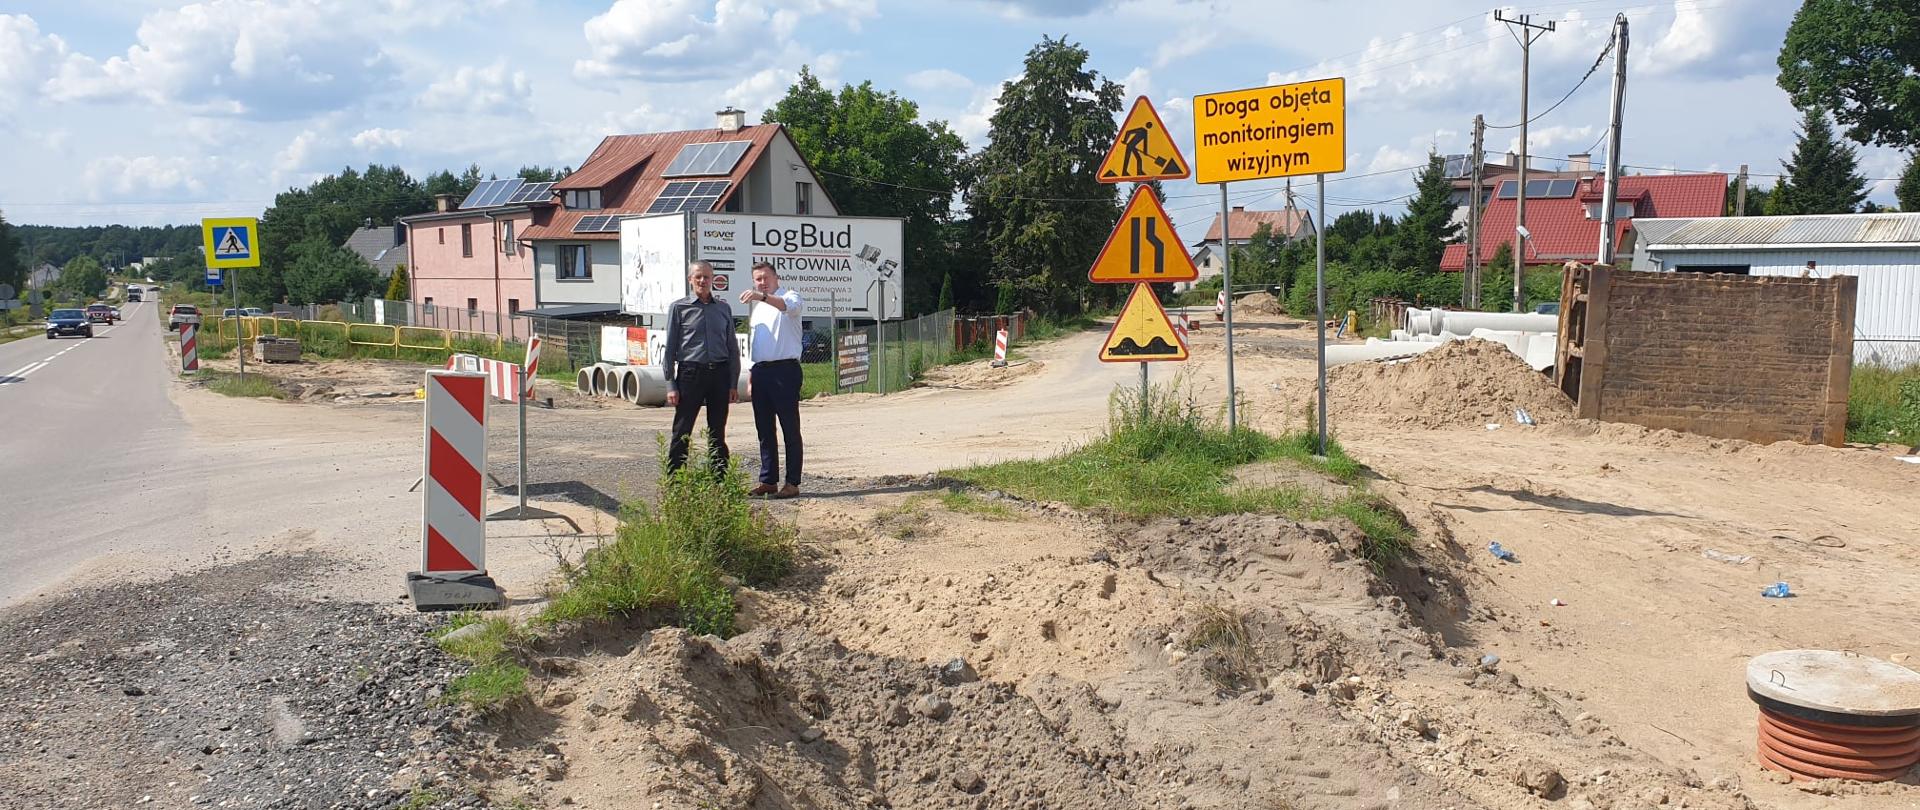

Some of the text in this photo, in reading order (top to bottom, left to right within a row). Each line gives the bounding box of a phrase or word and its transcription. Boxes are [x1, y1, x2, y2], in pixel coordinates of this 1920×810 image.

[1205, 87, 1331, 119] Droga objęta
[1203, 117, 1334, 147] monitoringiem
[1227, 149, 1310, 175] wizyjnym
[752, 221, 852, 252] LogBud
[800, 275, 853, 283] BUDOWLANYCH
[800, 286, 847, 294] KASZTANOWA
